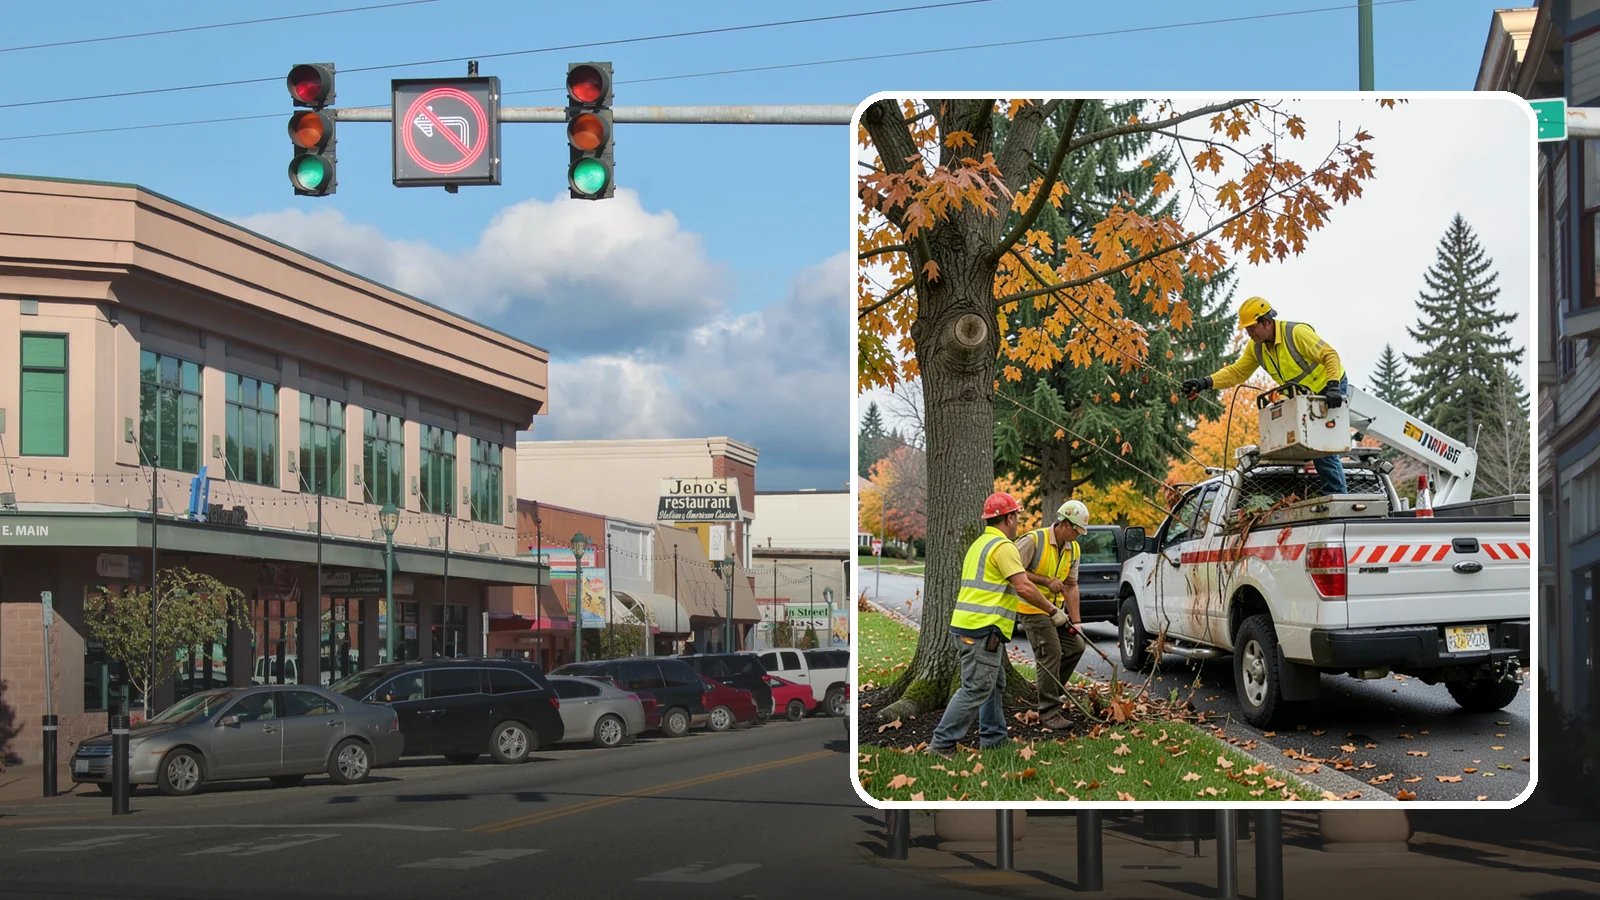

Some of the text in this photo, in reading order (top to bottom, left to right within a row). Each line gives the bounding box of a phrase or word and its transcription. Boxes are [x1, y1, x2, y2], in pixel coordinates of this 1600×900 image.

[670, 481, 727, 494] Jeno's
[665, 496, 731, 509] restaurant
[658, 509, 681, 519] Italian
[686, 509, 714, 519] American
[714, 509, 737, 519] Cuisine
[2, 525, 49, 536] E. MAIN
[786, 607, 795, 617] in
[797, 607, 828, 617] Street
